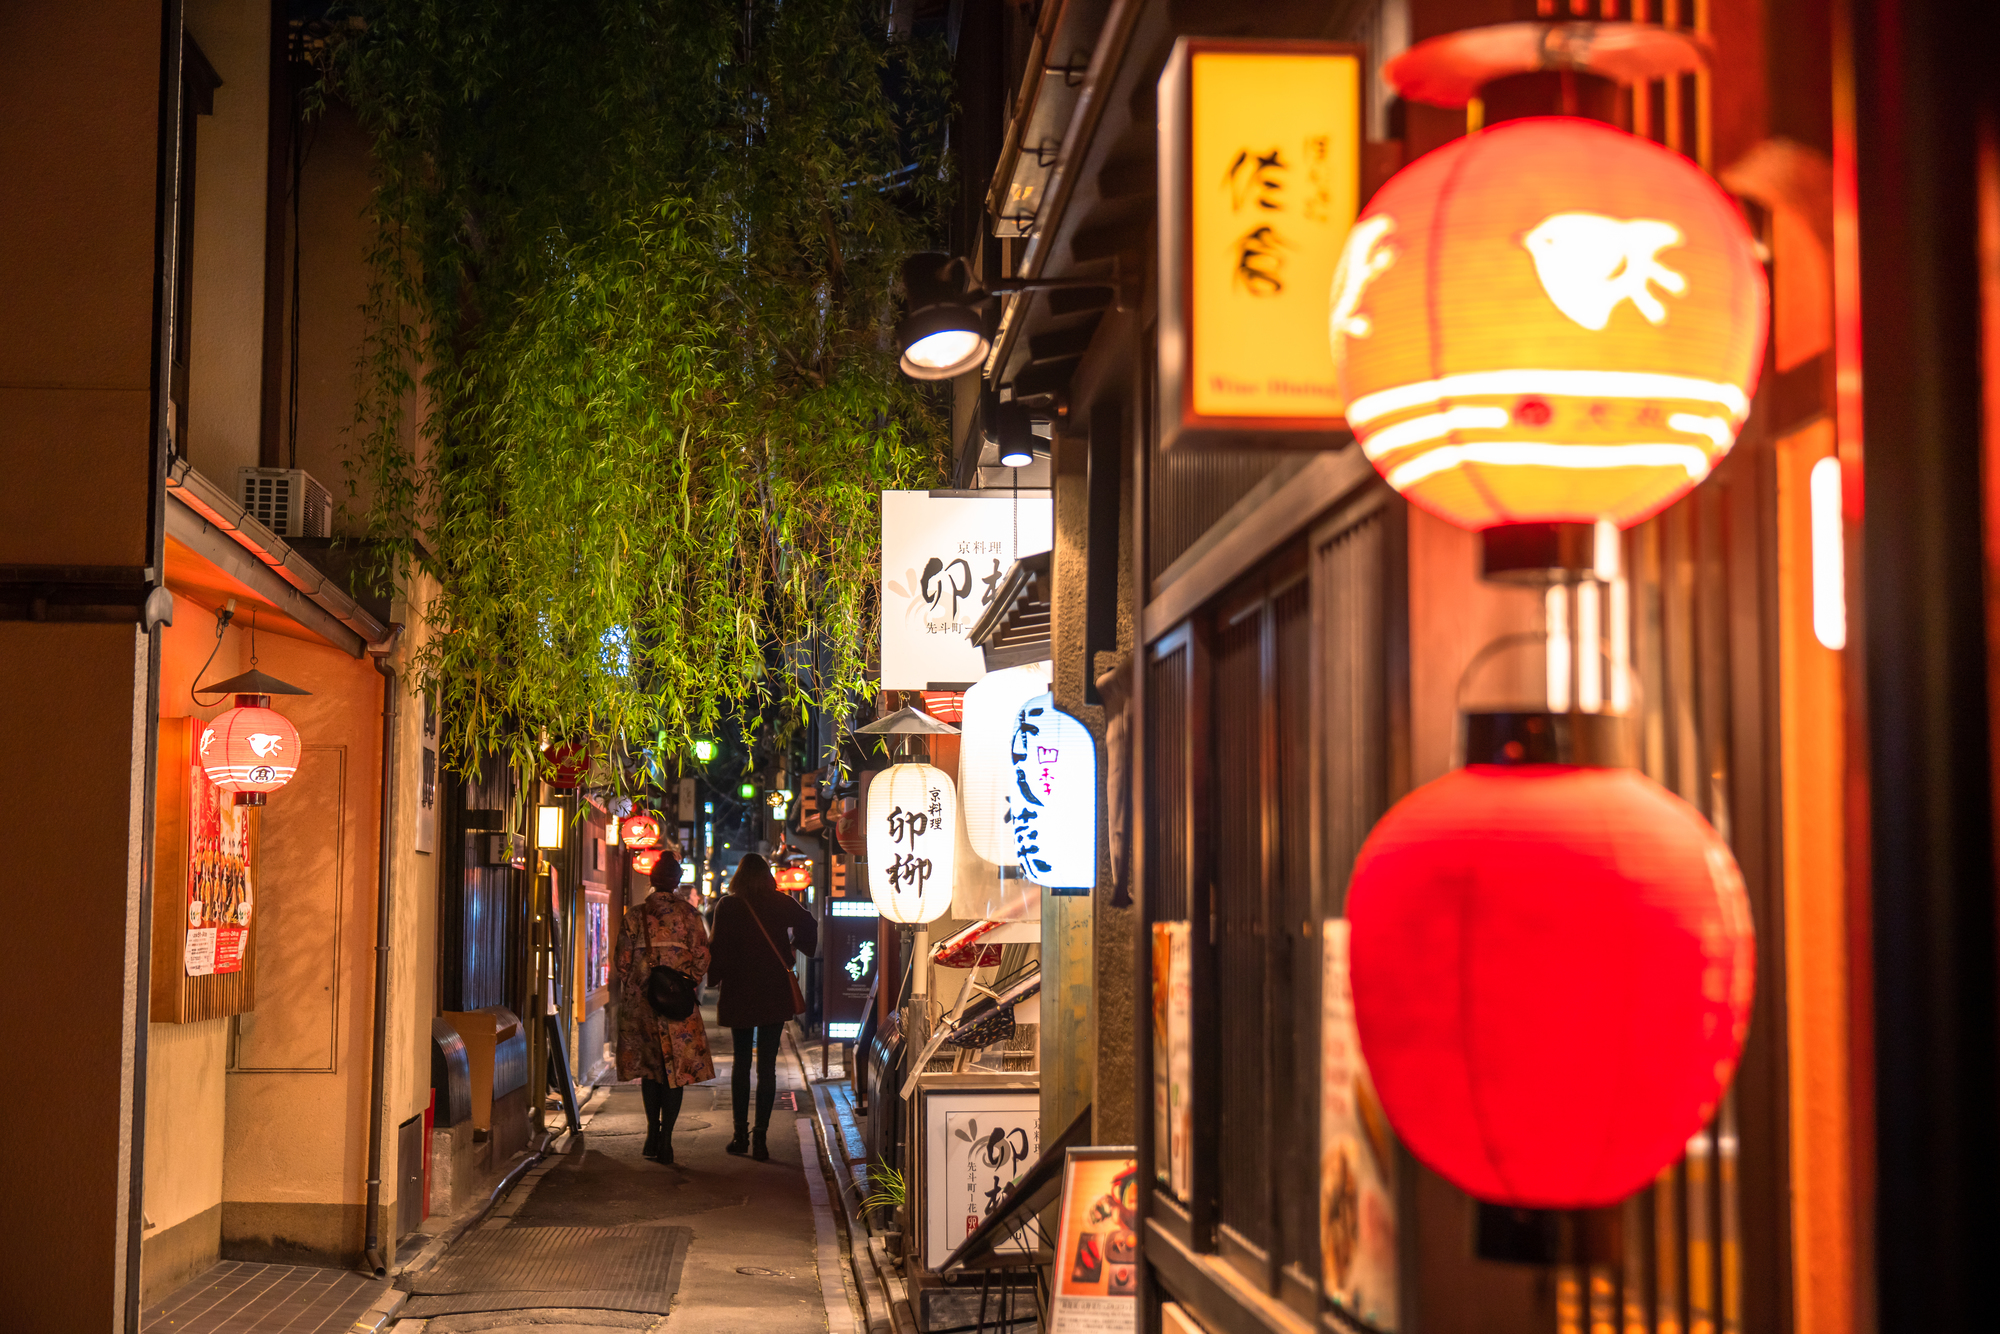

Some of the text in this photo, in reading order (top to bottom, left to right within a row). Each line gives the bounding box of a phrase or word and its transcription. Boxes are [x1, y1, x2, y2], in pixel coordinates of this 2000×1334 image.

[957, 541, 1002, 554] 京料理
[928, 787, 942, 830] 京料理
[886, 806, 932, 899] 卯柳
